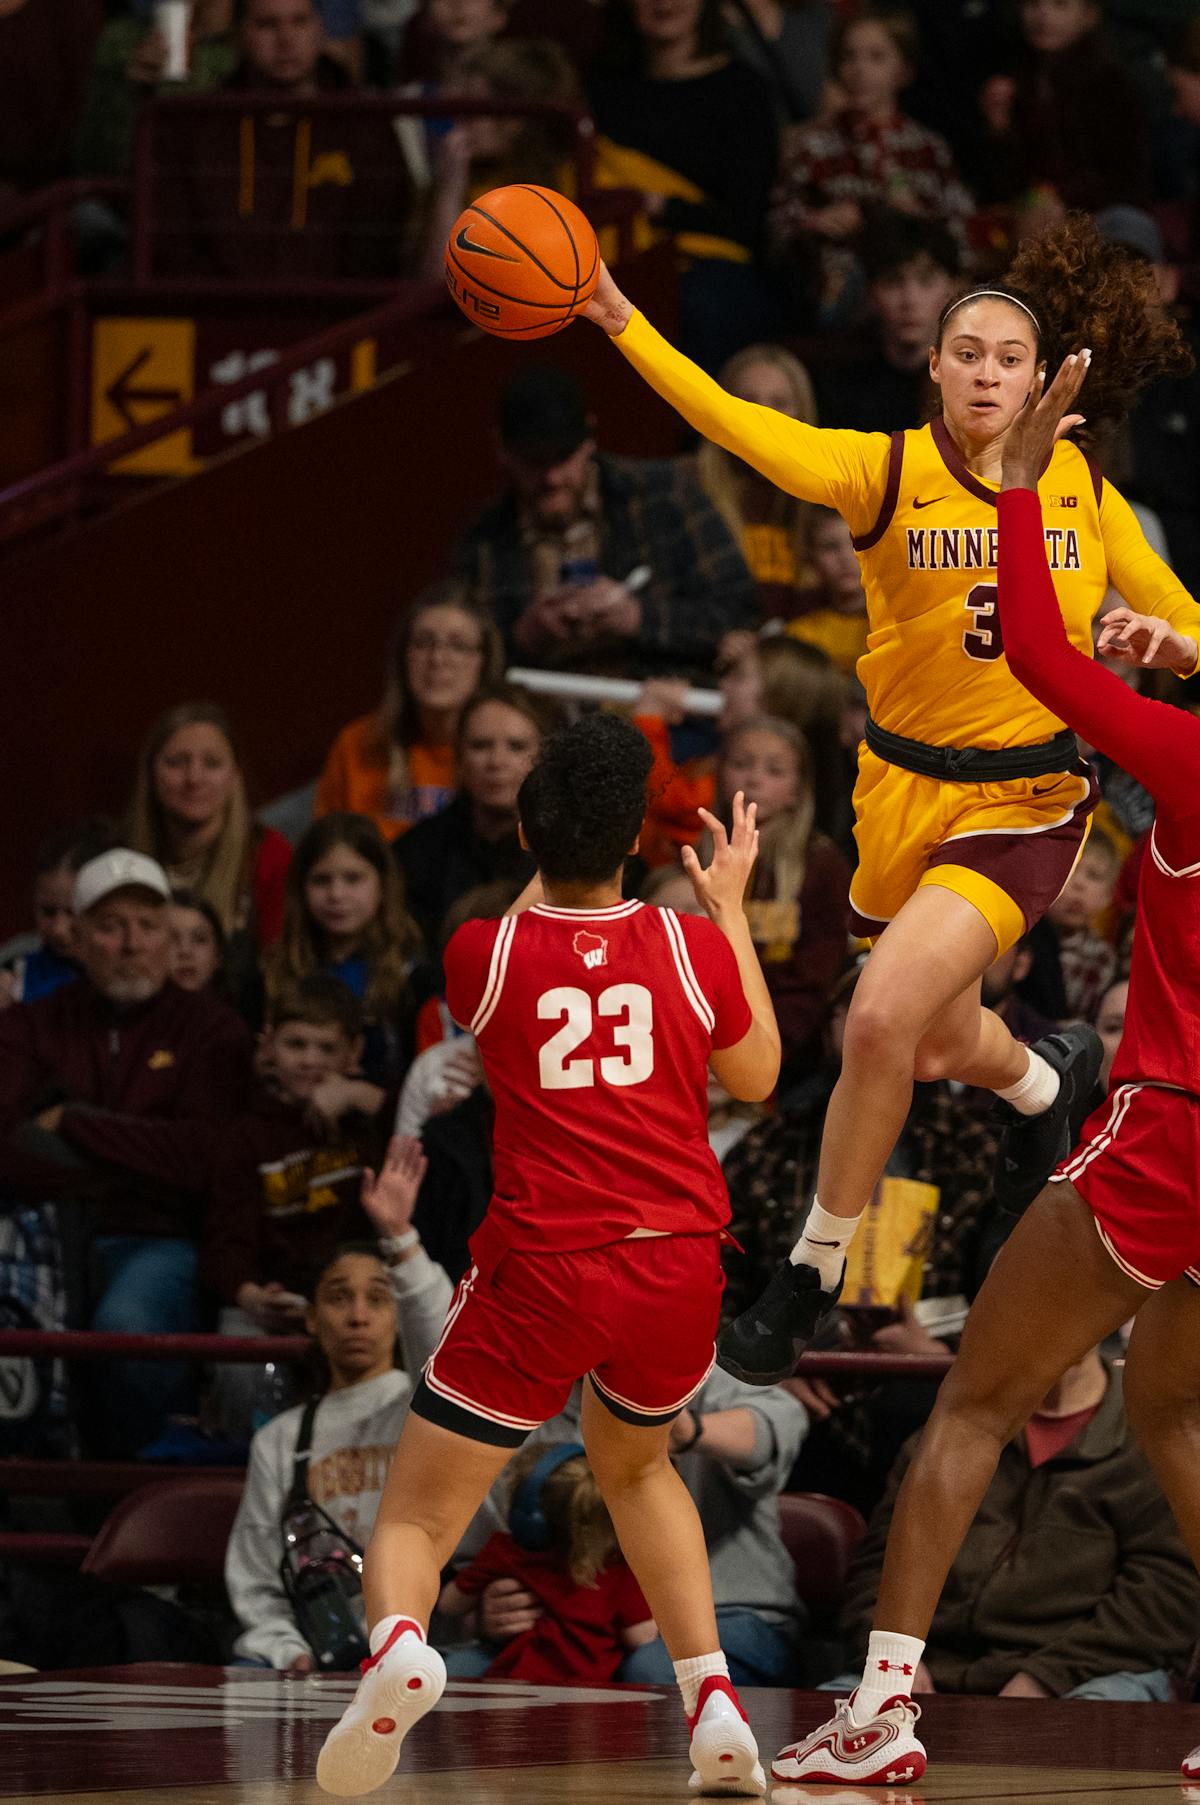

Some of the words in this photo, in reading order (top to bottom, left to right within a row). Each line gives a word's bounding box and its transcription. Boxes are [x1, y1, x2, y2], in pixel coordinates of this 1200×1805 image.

[906, 527, 1084, 571] MINNETA
[962, 582, 1004, 662] 3
[536, 982, 655, 1090] 23
